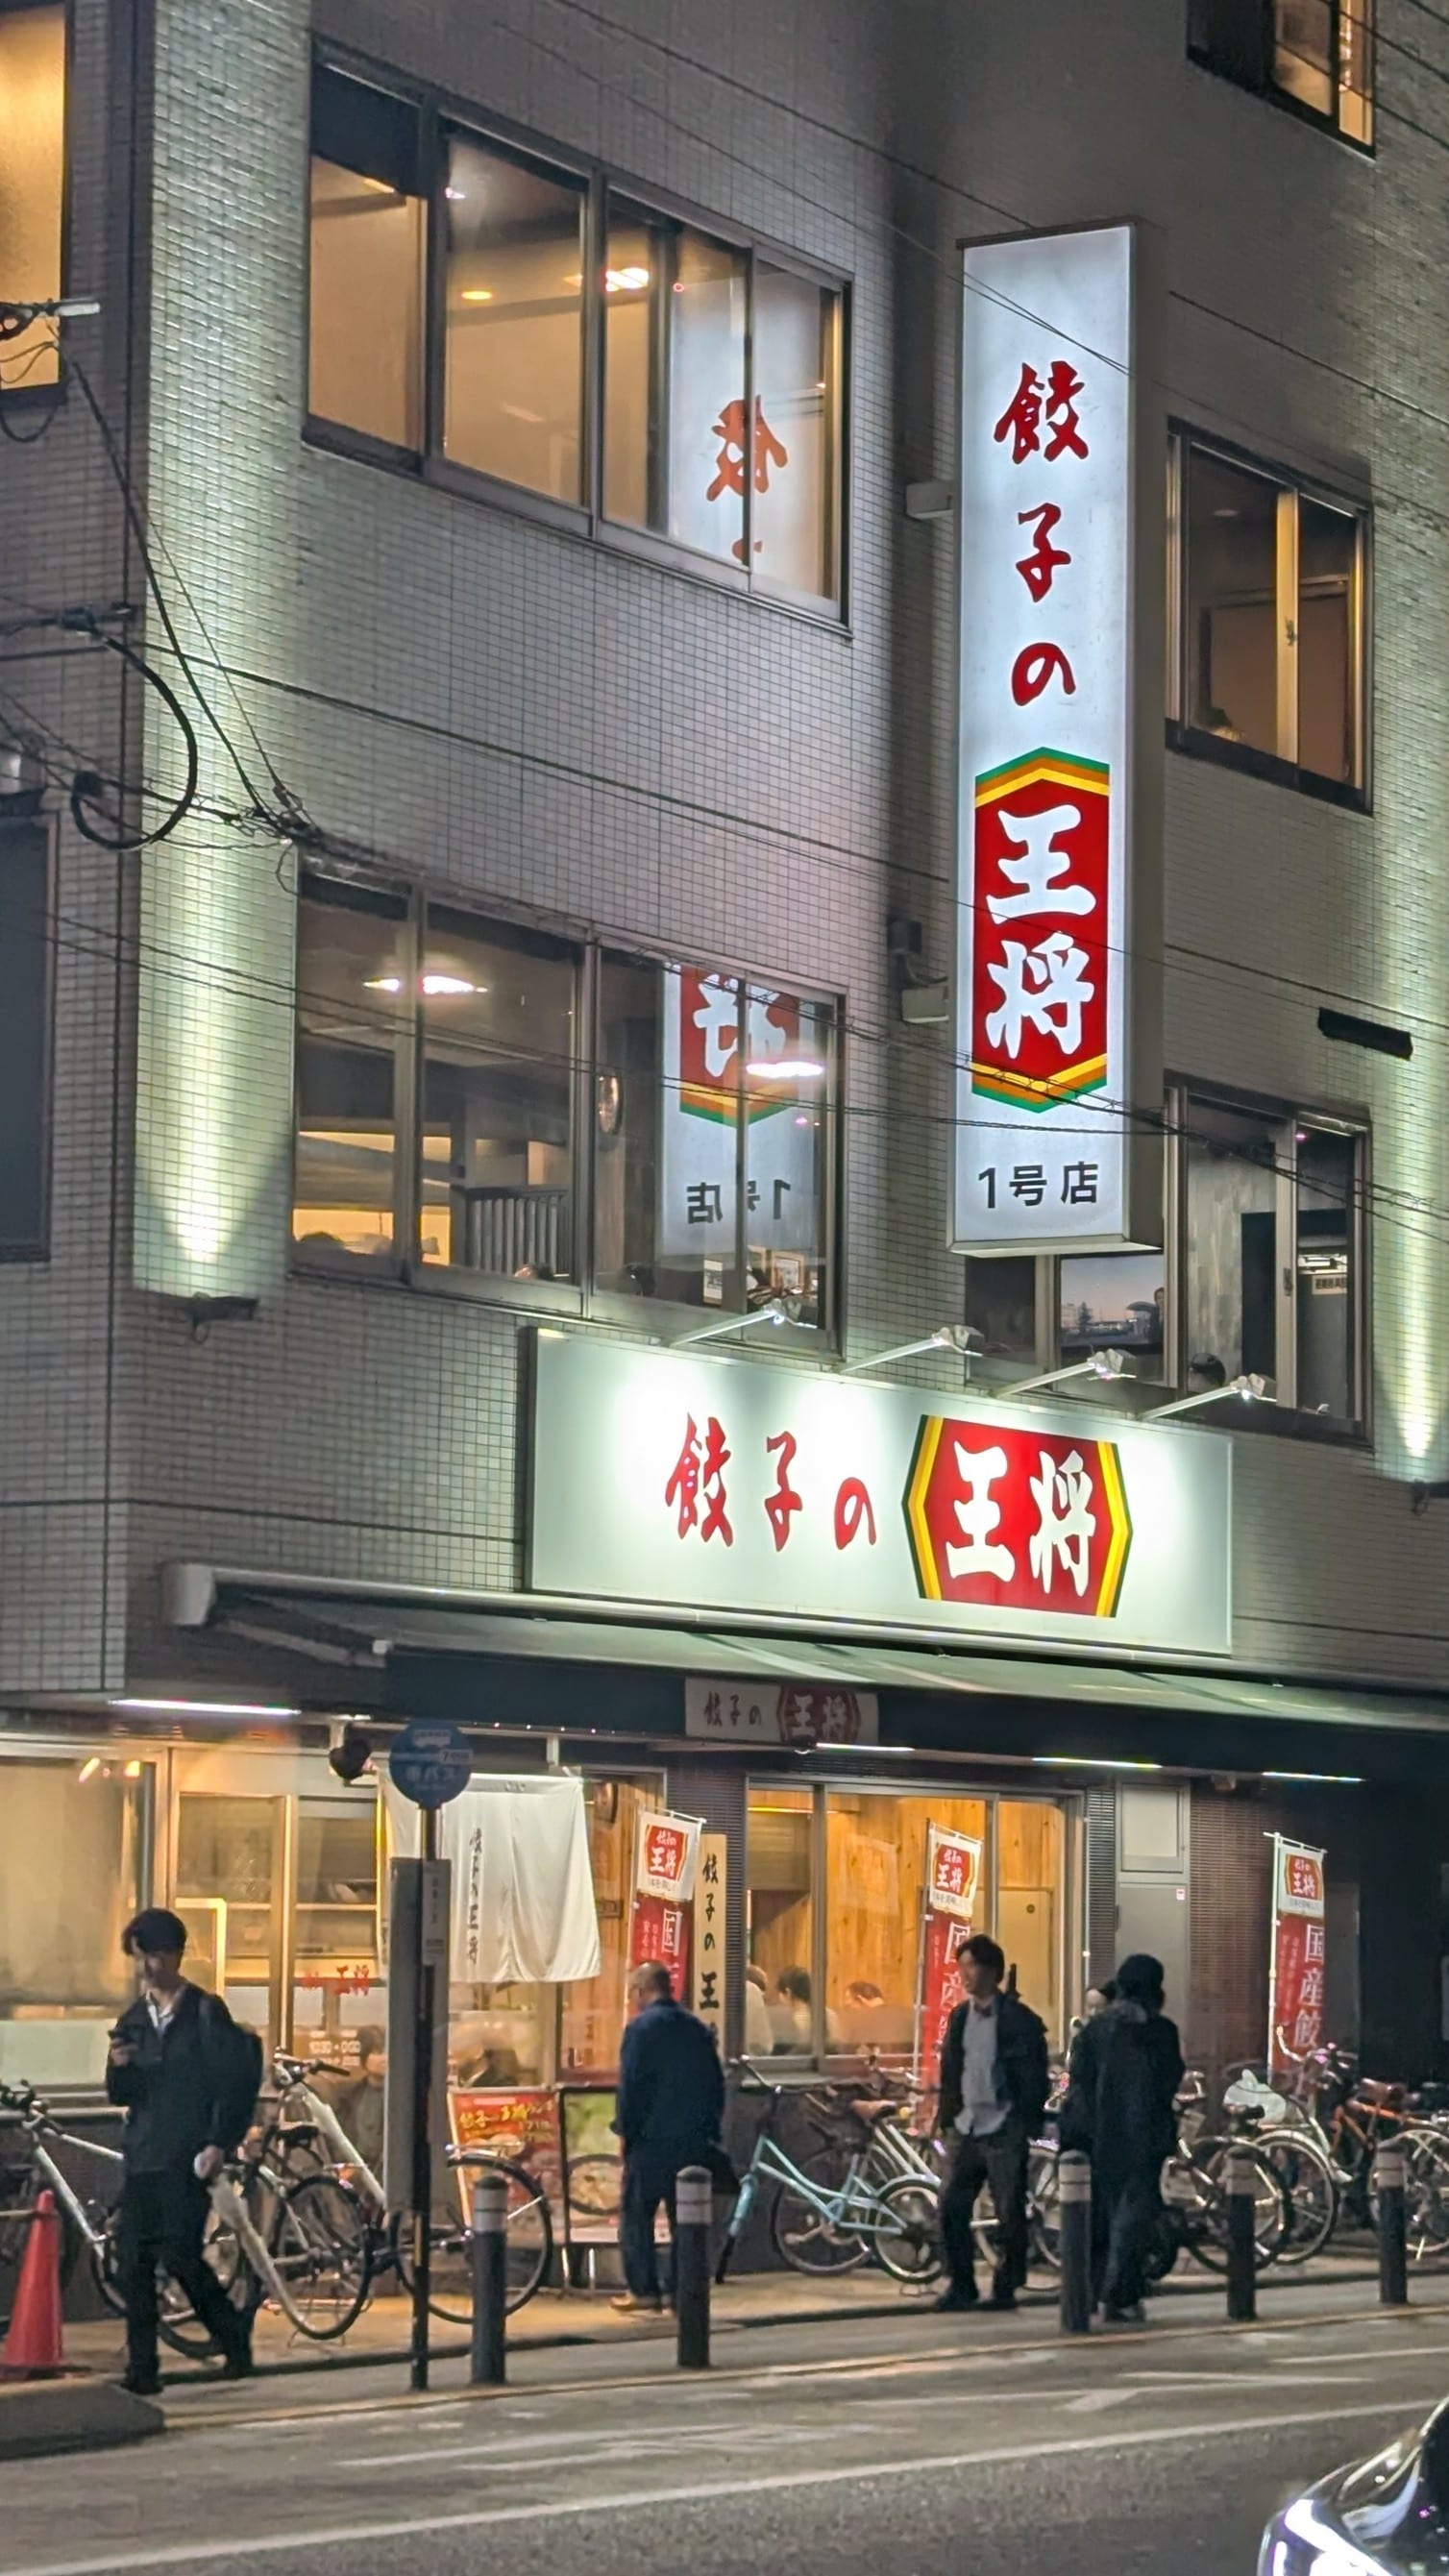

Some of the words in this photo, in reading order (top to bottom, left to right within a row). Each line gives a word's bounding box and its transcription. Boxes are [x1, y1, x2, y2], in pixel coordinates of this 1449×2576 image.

[986, 359, 1096, 1059] 餃子の王将
[978, 1161, 1098, 1209] 1号店
[665, 1412, 1096, 1597] 餃子の王将
[703, 1690, 848, 1744] 餃子の王将
[650, 1847, 676, 1877] 王将
[936, 1863, 963, 1894] 王将
[1292, 1872, 1315, 1898] 王将
[700, 1854, 720, 2047] 餃子の王
